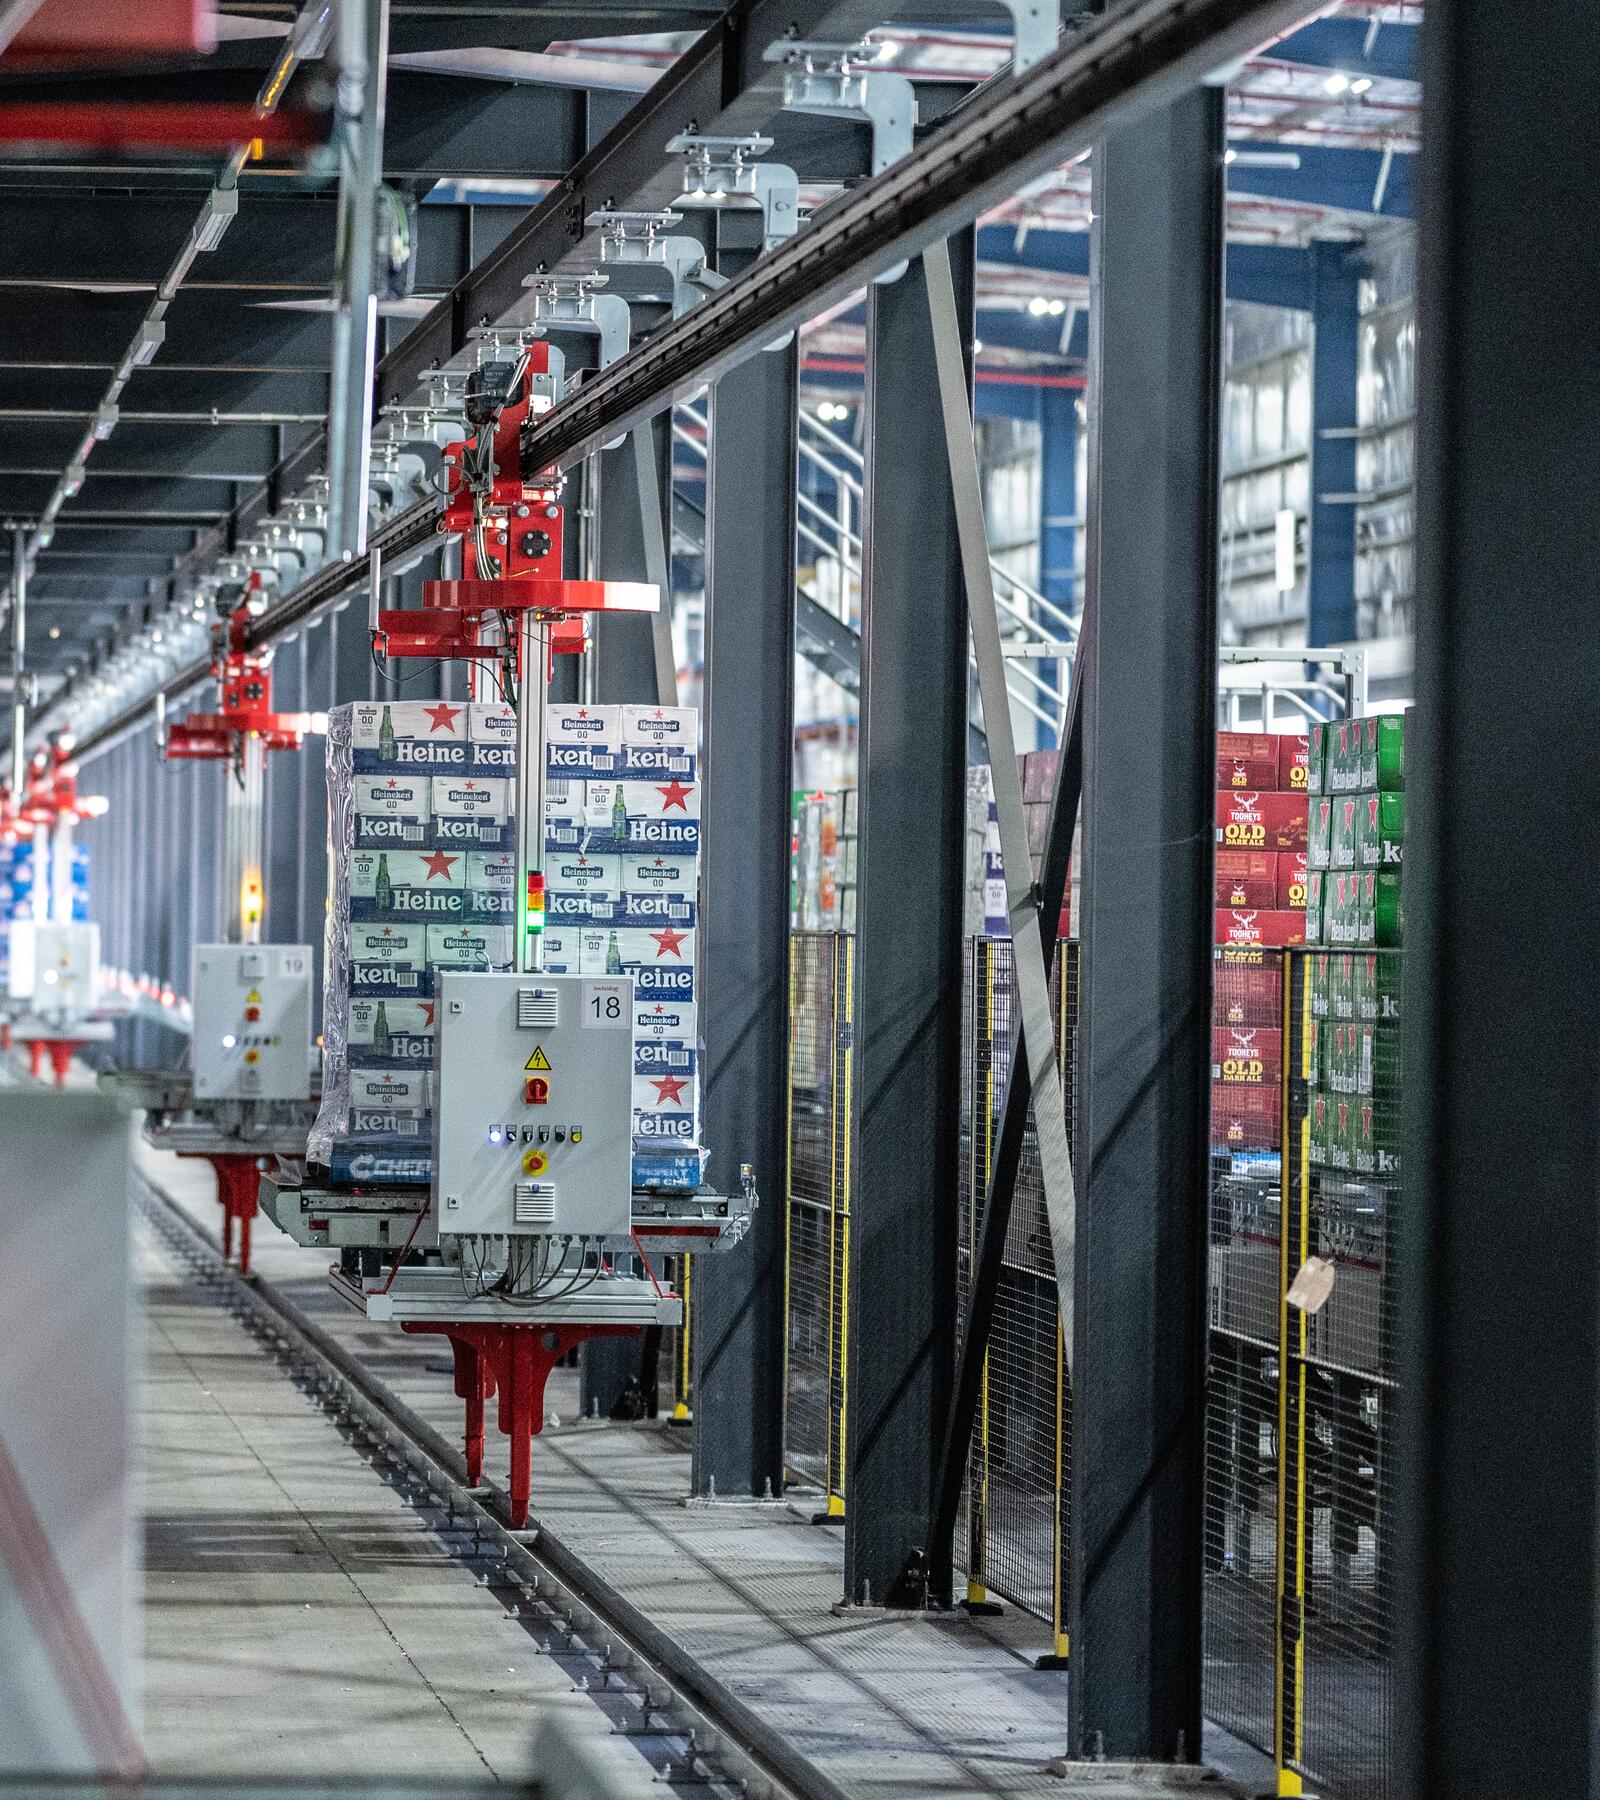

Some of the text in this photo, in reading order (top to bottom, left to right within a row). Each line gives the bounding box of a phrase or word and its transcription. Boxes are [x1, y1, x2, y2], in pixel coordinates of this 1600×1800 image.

[564, 721, 601, 729] Heineken
[640, 721, 677, 730] Heineken
[396, 742, 465, 763] Heine
[473, 745, 516, 765] ken
[549, 746, 594, 765] ken
[625, 748, 670, 767] ken
[373, 790, 411, 799] Heineken
[451, 792, 489, 801] Heineken
[1231, 812, 1261, 820] TOOHEYS
[360, 817, 404, 836] ken
[436, 818, 481, 837] ken
[629, 821, 697, 841] Heine
[1225, 824, 1265, 839] OLD
[1384, 840, 1403, 862] k
[563, 868, 601, 876] Heineken
[640, 869, 677, 878] Heineken
[393, 890, 461, 910] Heine
[472, 892, 514, 912] ken
[549, 894, 593, 914] ken
[625, 894, 670, 914] ken
[368, 938, 406, 947] Heineken
[1229, 929, 1260, 938] TOOHEYS
[445, 939, 484, 948] Heineken
[353, 964, 399, 984] ken
[591, 996, 621, 1018] 18
[640, 1016, 677, 1024] Heineken
[392, 1038, 434, 1058] Hei
[1223, 1060, 1263, 1075] OLD
[368, 1085, 406, 1093] Heineken
[354, 1111, 398, 1131] ken
